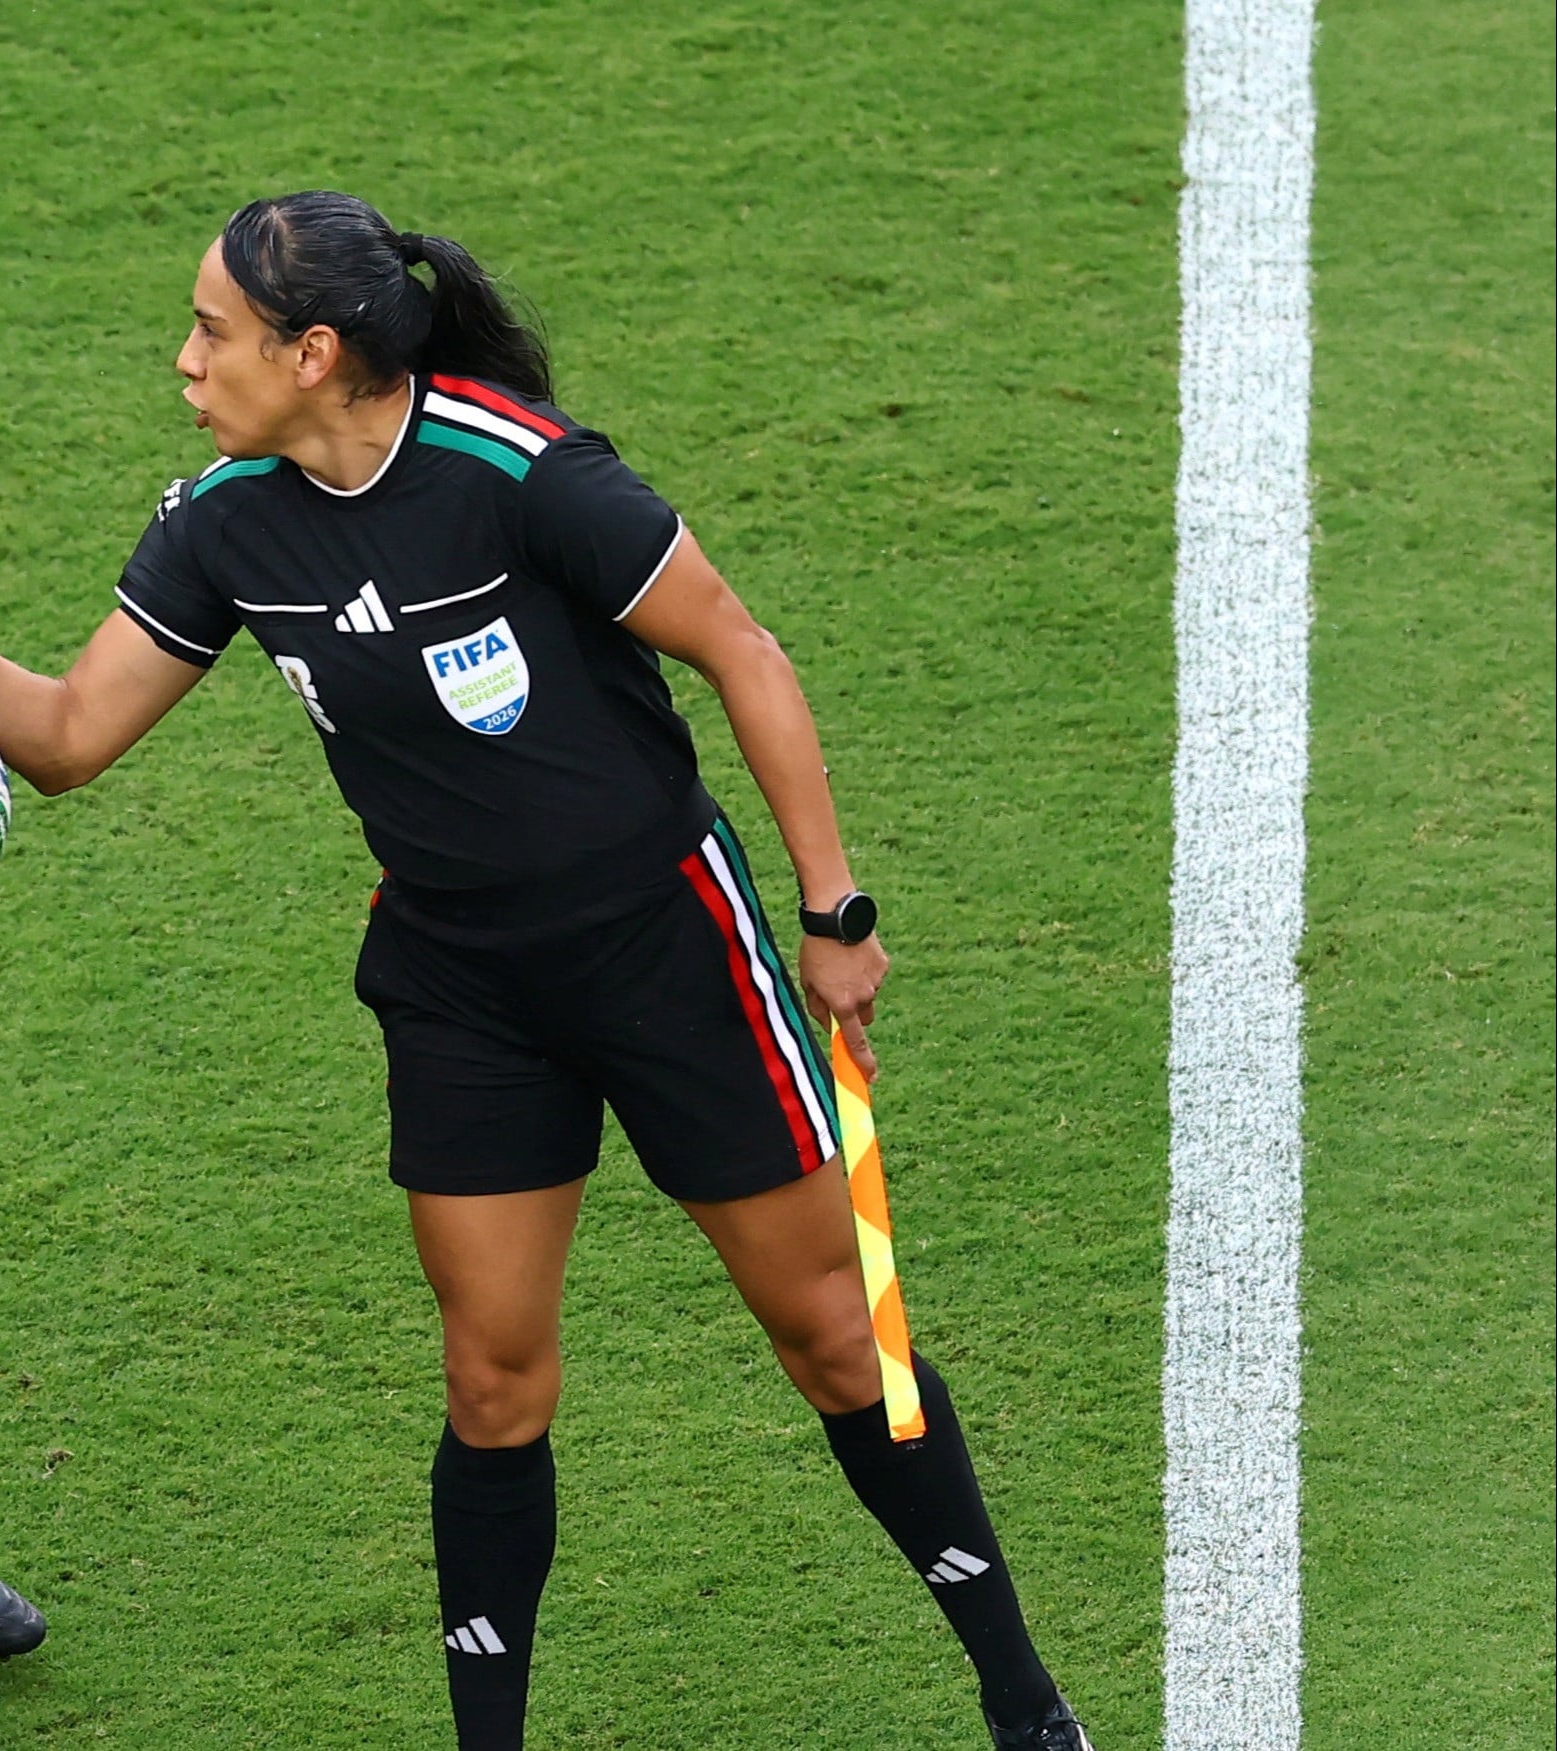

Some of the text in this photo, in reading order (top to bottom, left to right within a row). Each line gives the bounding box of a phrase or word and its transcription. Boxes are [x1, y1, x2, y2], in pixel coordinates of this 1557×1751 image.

[432, 632, 509, 678] FIFA
[449, 661, 517, 700] ASSISTANT
[458, 675, 519, 710] REFEREE
[483, 704, 518, 730] 2026
